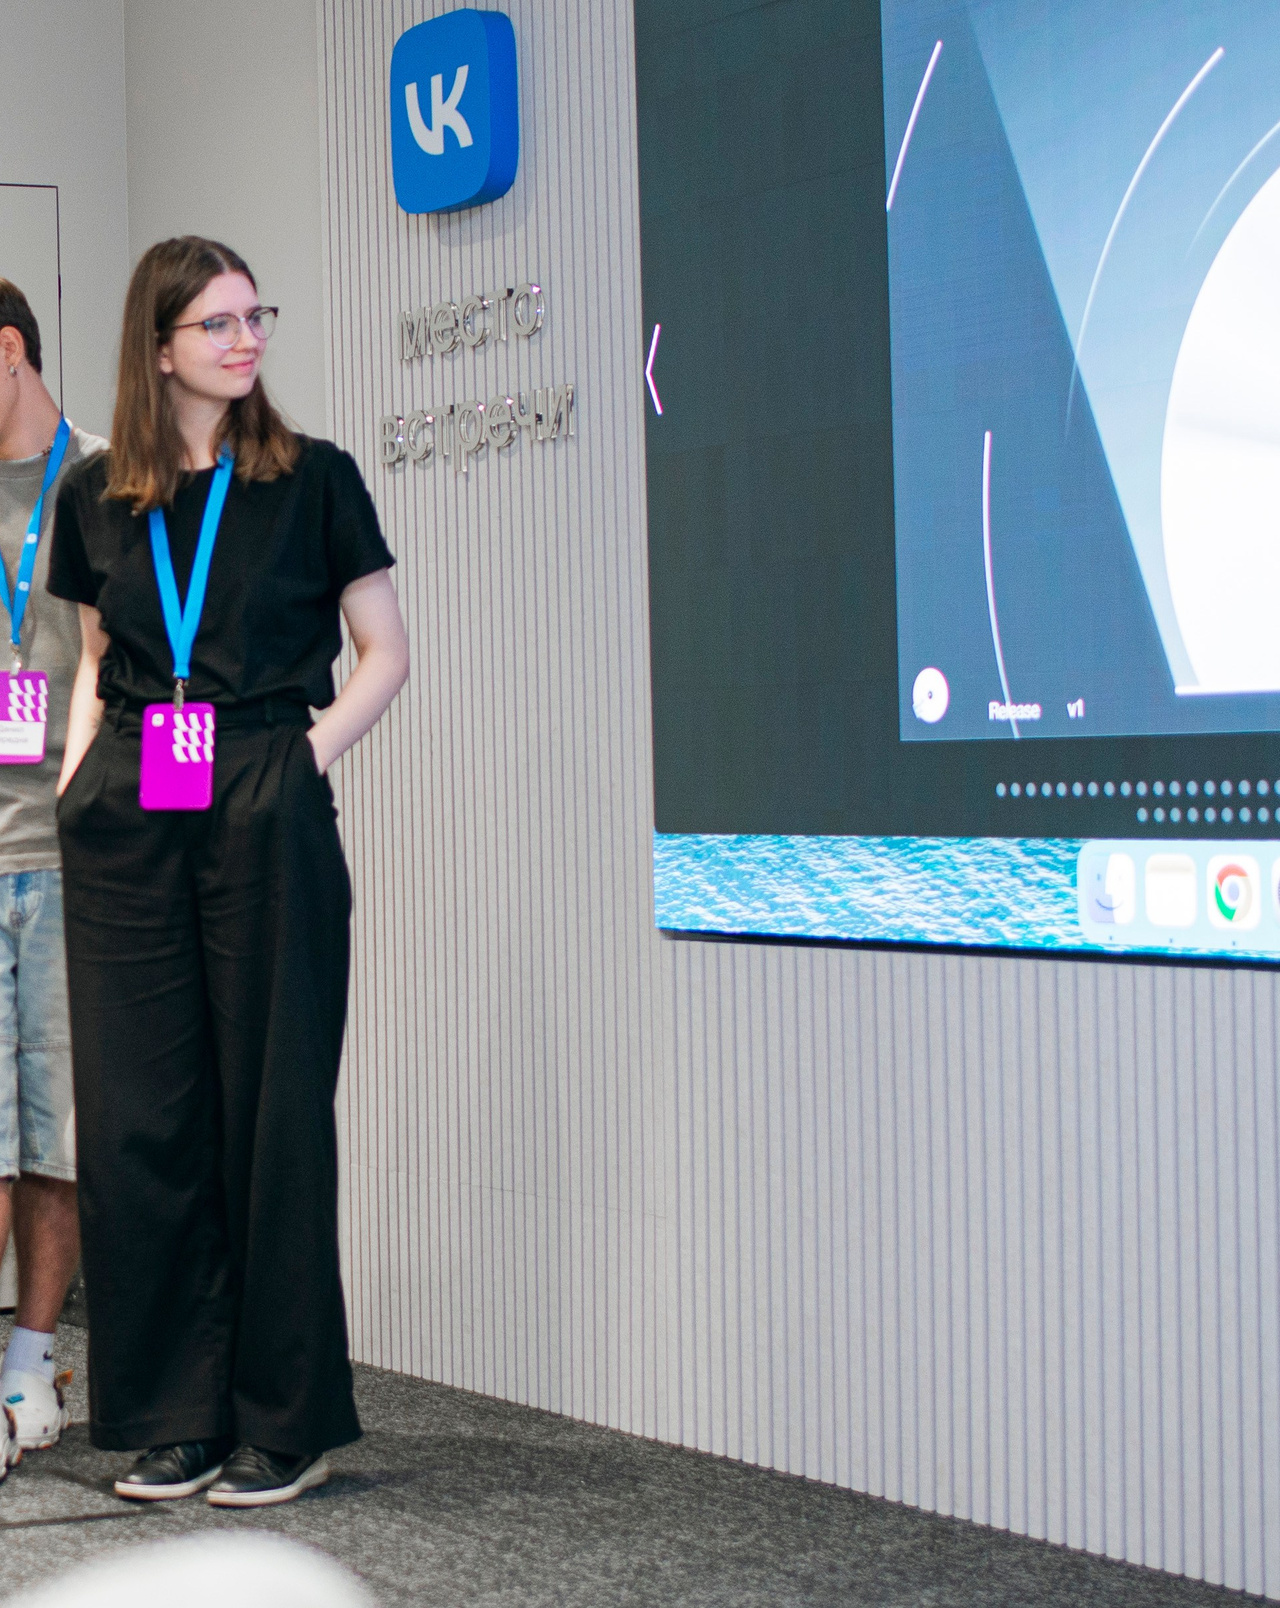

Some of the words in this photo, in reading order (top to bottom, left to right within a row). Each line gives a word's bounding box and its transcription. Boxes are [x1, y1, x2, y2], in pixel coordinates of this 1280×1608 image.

[405, 64, 473, 155] VK
[397, 282, 546, 364] место
[380, 384, 574, 474] встречи
[988, 701, 1042, 721] Release
[1066, 698, 1085, 719] v1
